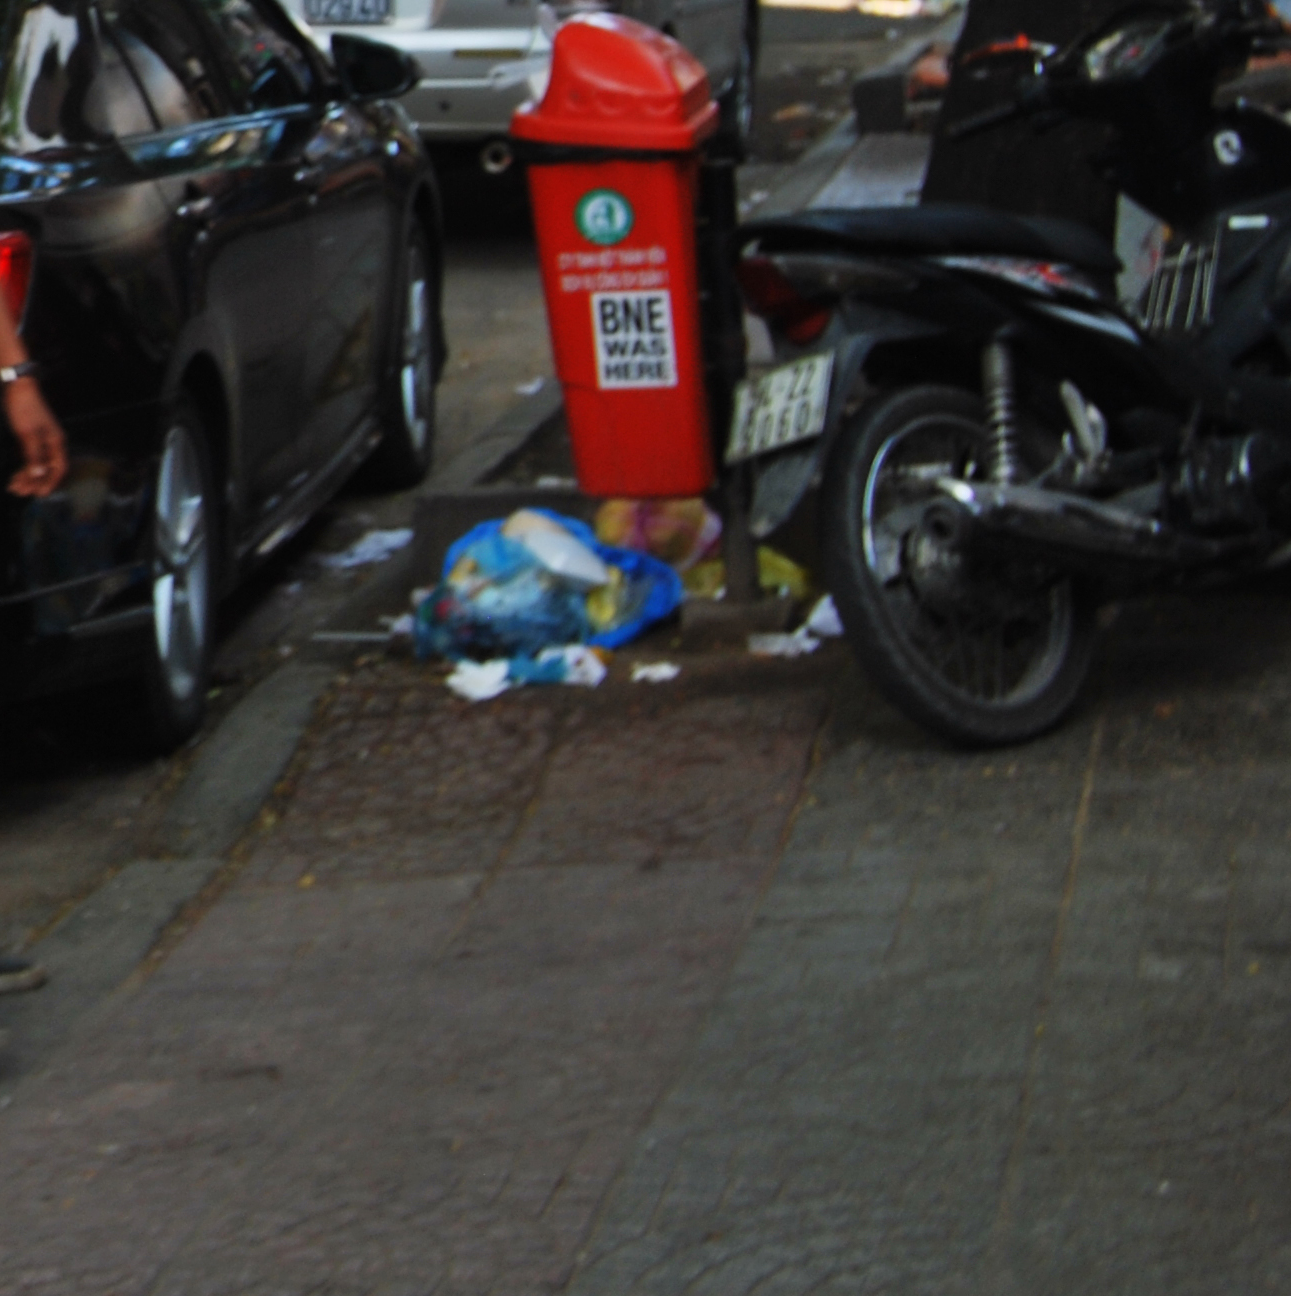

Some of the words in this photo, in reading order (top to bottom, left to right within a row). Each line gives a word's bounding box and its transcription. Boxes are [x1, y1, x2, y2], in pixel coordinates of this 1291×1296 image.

[600, 298, 665, 334] BNE
[604, 339, 666, 357] WAS
[605, 362, 668, 381] HERE
